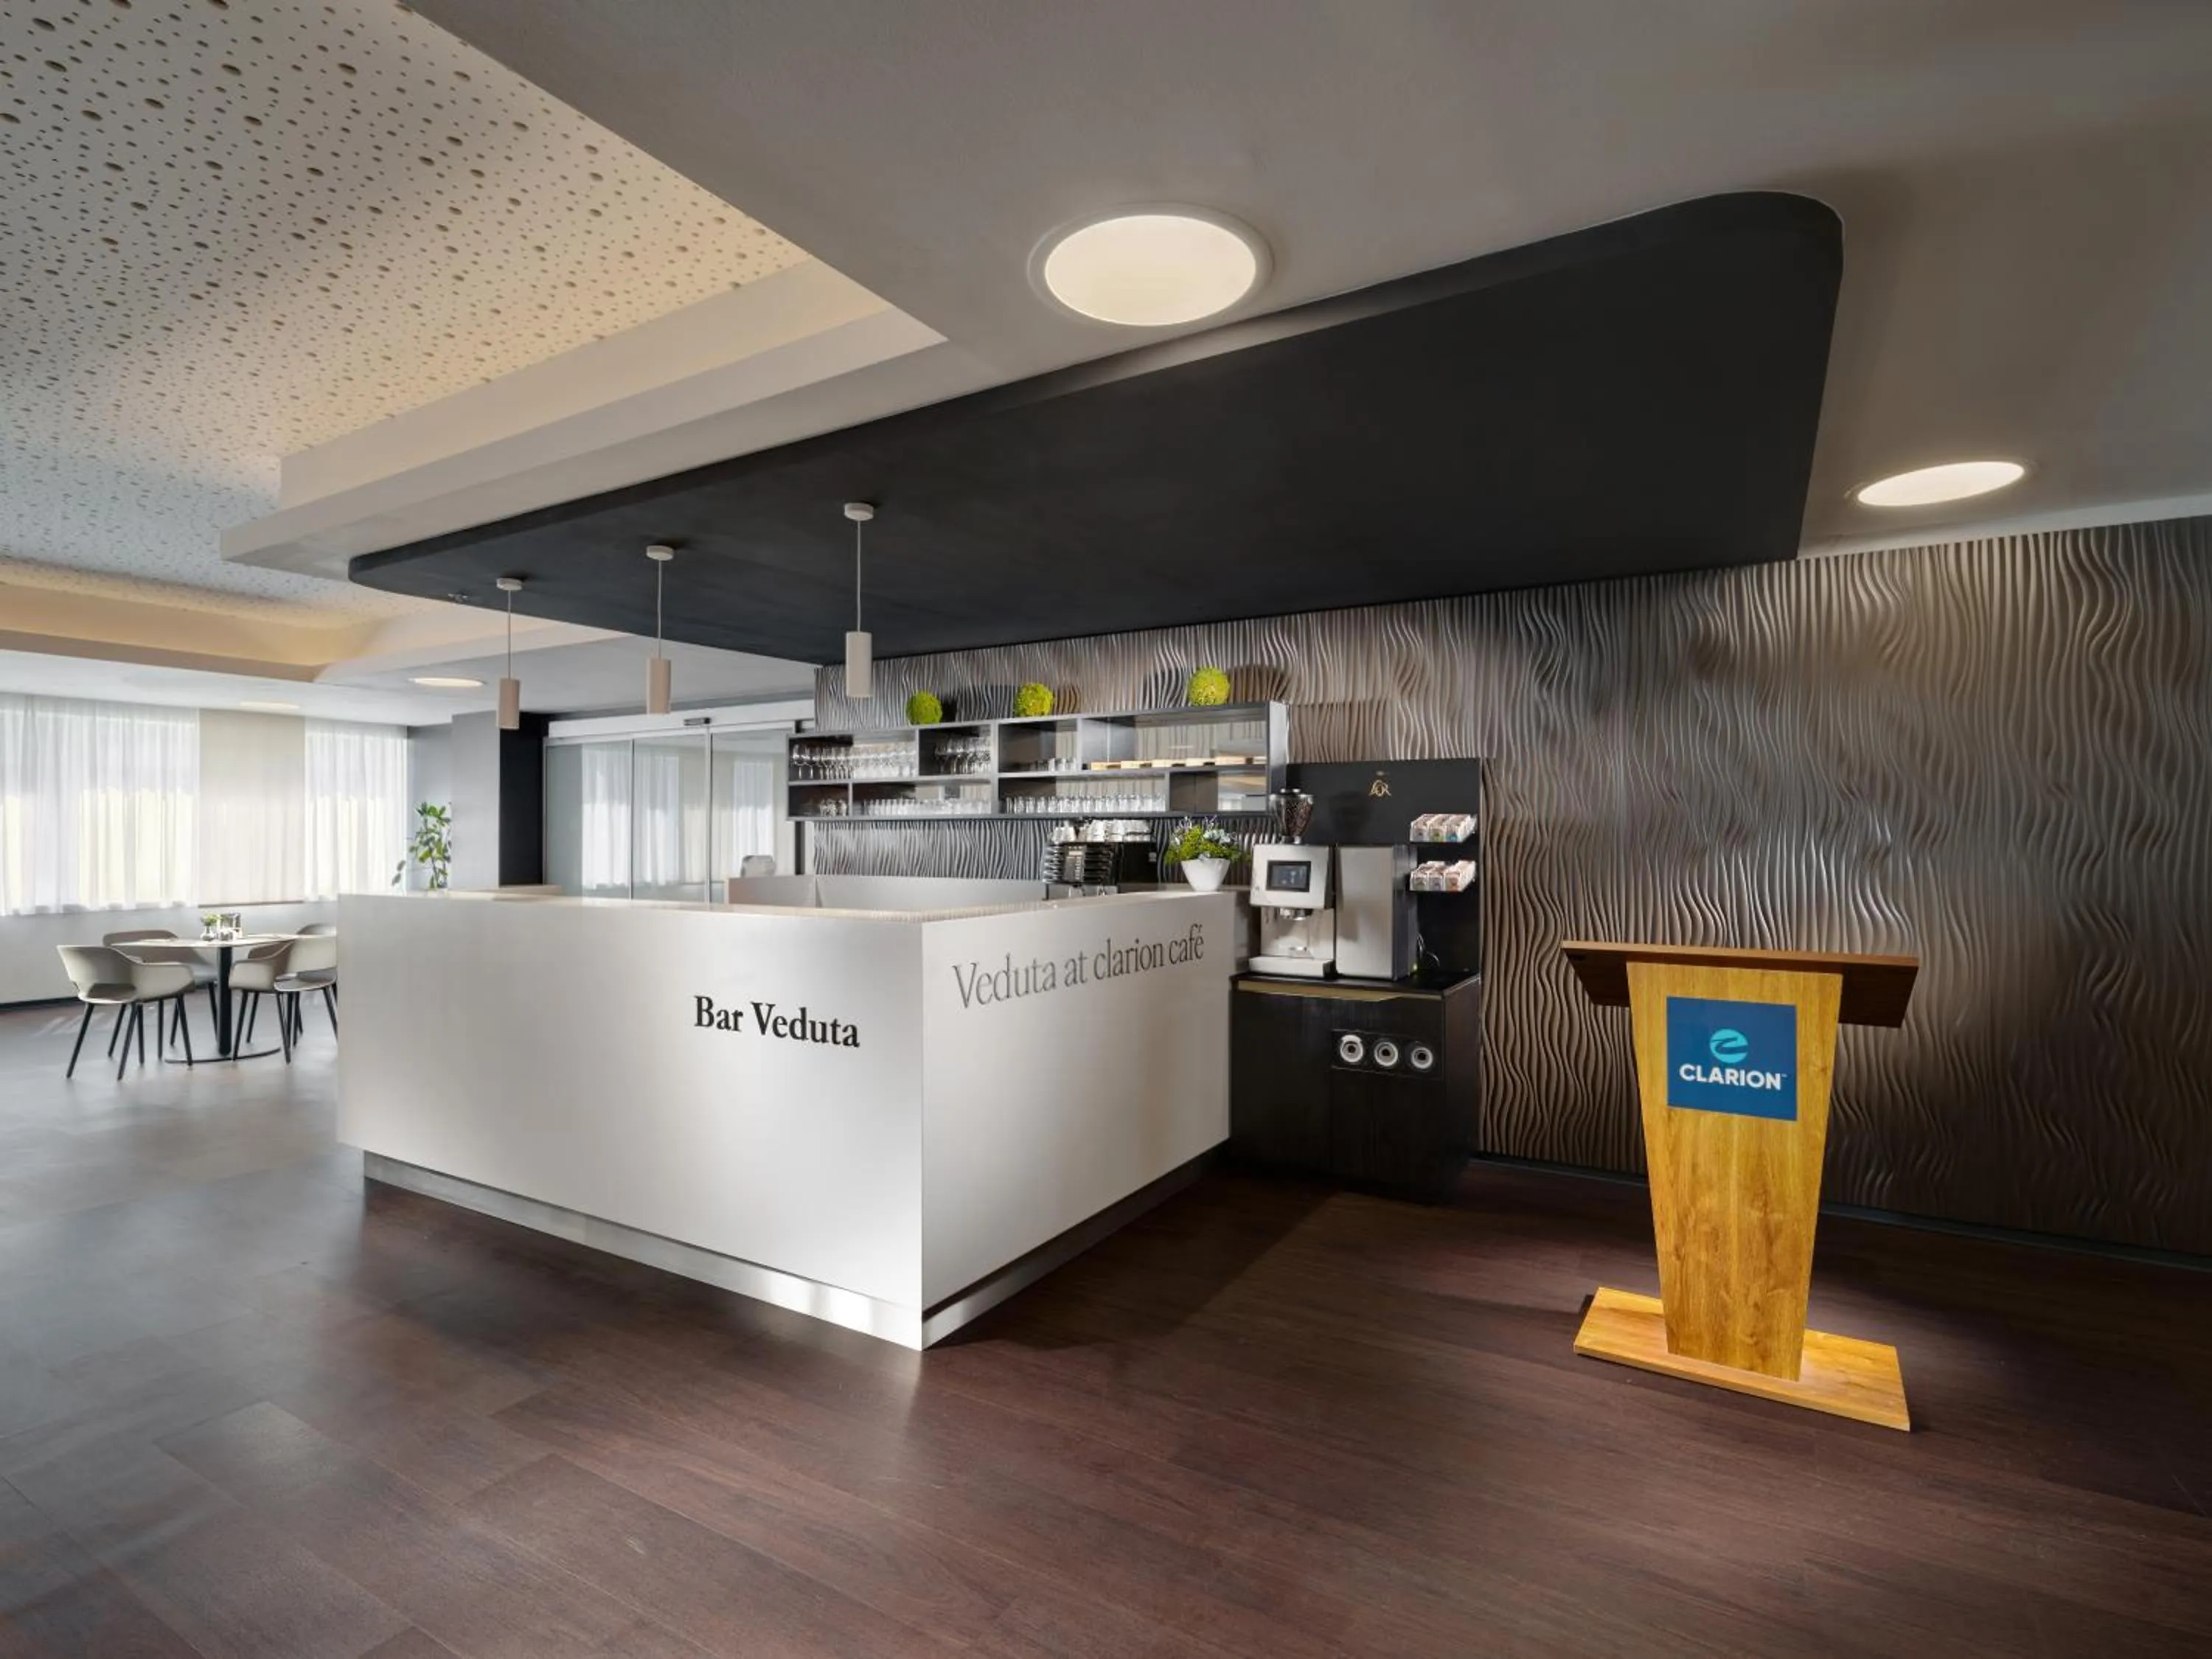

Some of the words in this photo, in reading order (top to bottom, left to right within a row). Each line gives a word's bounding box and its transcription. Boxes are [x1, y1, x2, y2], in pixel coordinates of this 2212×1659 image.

[951, 952, 1057, 1009] Veduta
[1064, 950, 1088, 988] at
[1093, 937, 1165, 980] clarion
[1168, 923, 1204, 965] café
[694, 995, 744, 1032] Bar
[750, 1001, 860, 1048] Veduta
[1679, 1062, 1781, 1091] CLARION
